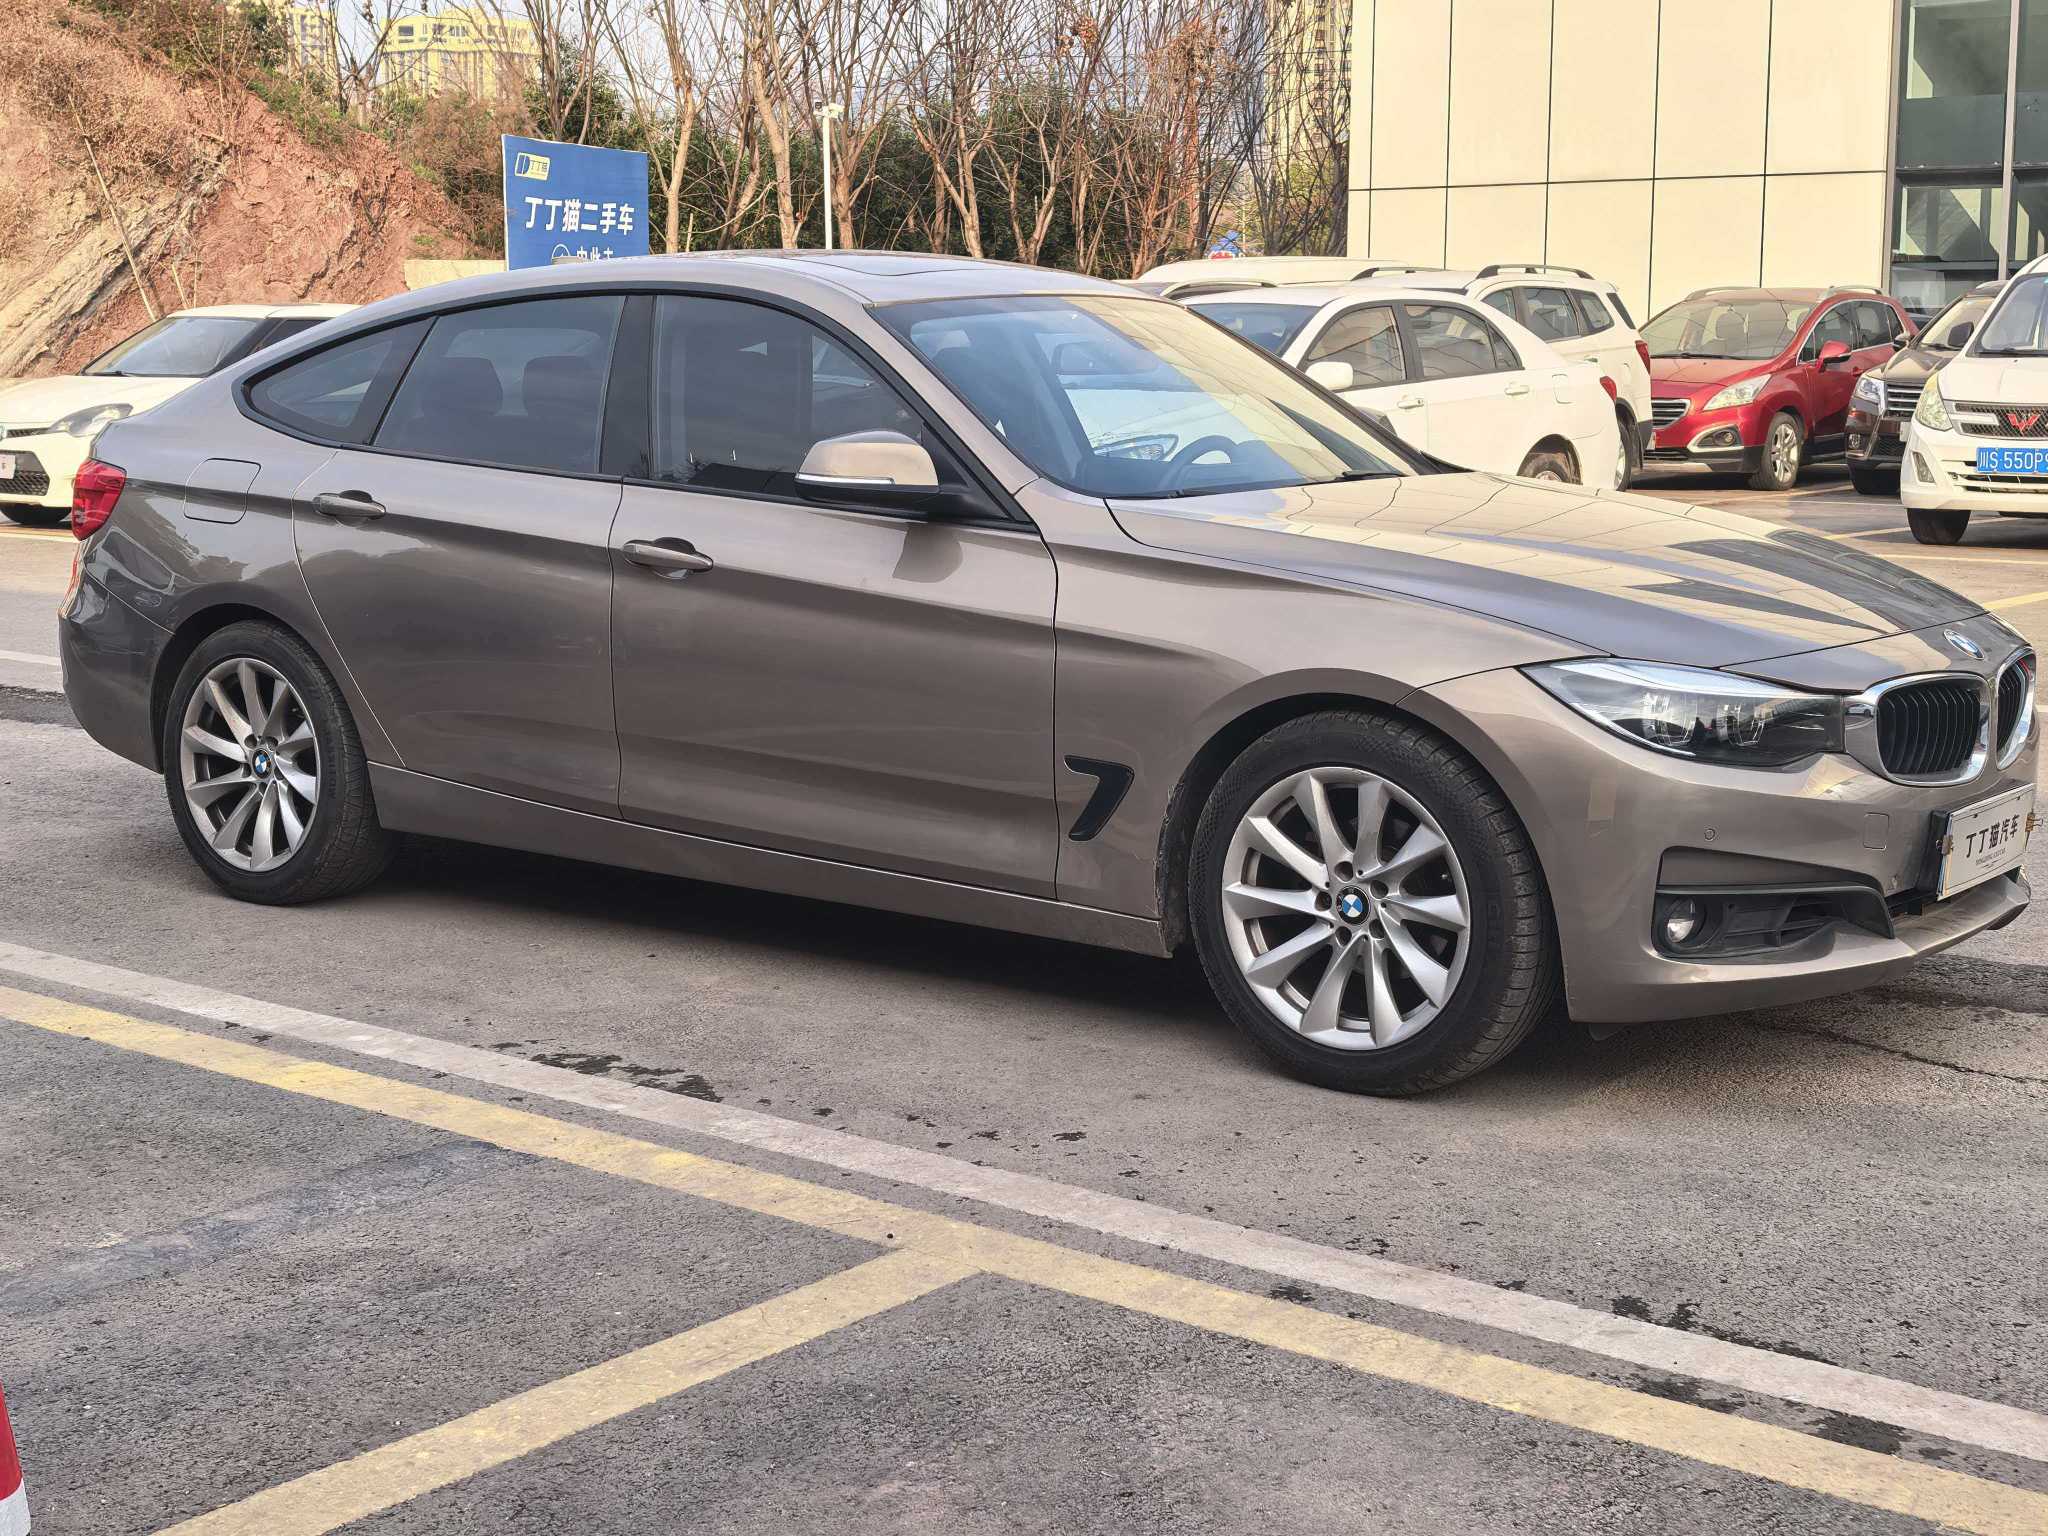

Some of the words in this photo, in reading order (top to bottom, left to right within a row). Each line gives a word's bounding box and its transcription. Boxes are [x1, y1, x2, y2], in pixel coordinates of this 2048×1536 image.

[525, 197, 635, 236] 丁丁猫二手车
[1966, 814, 2020, 858] 丁丁猫汽车
